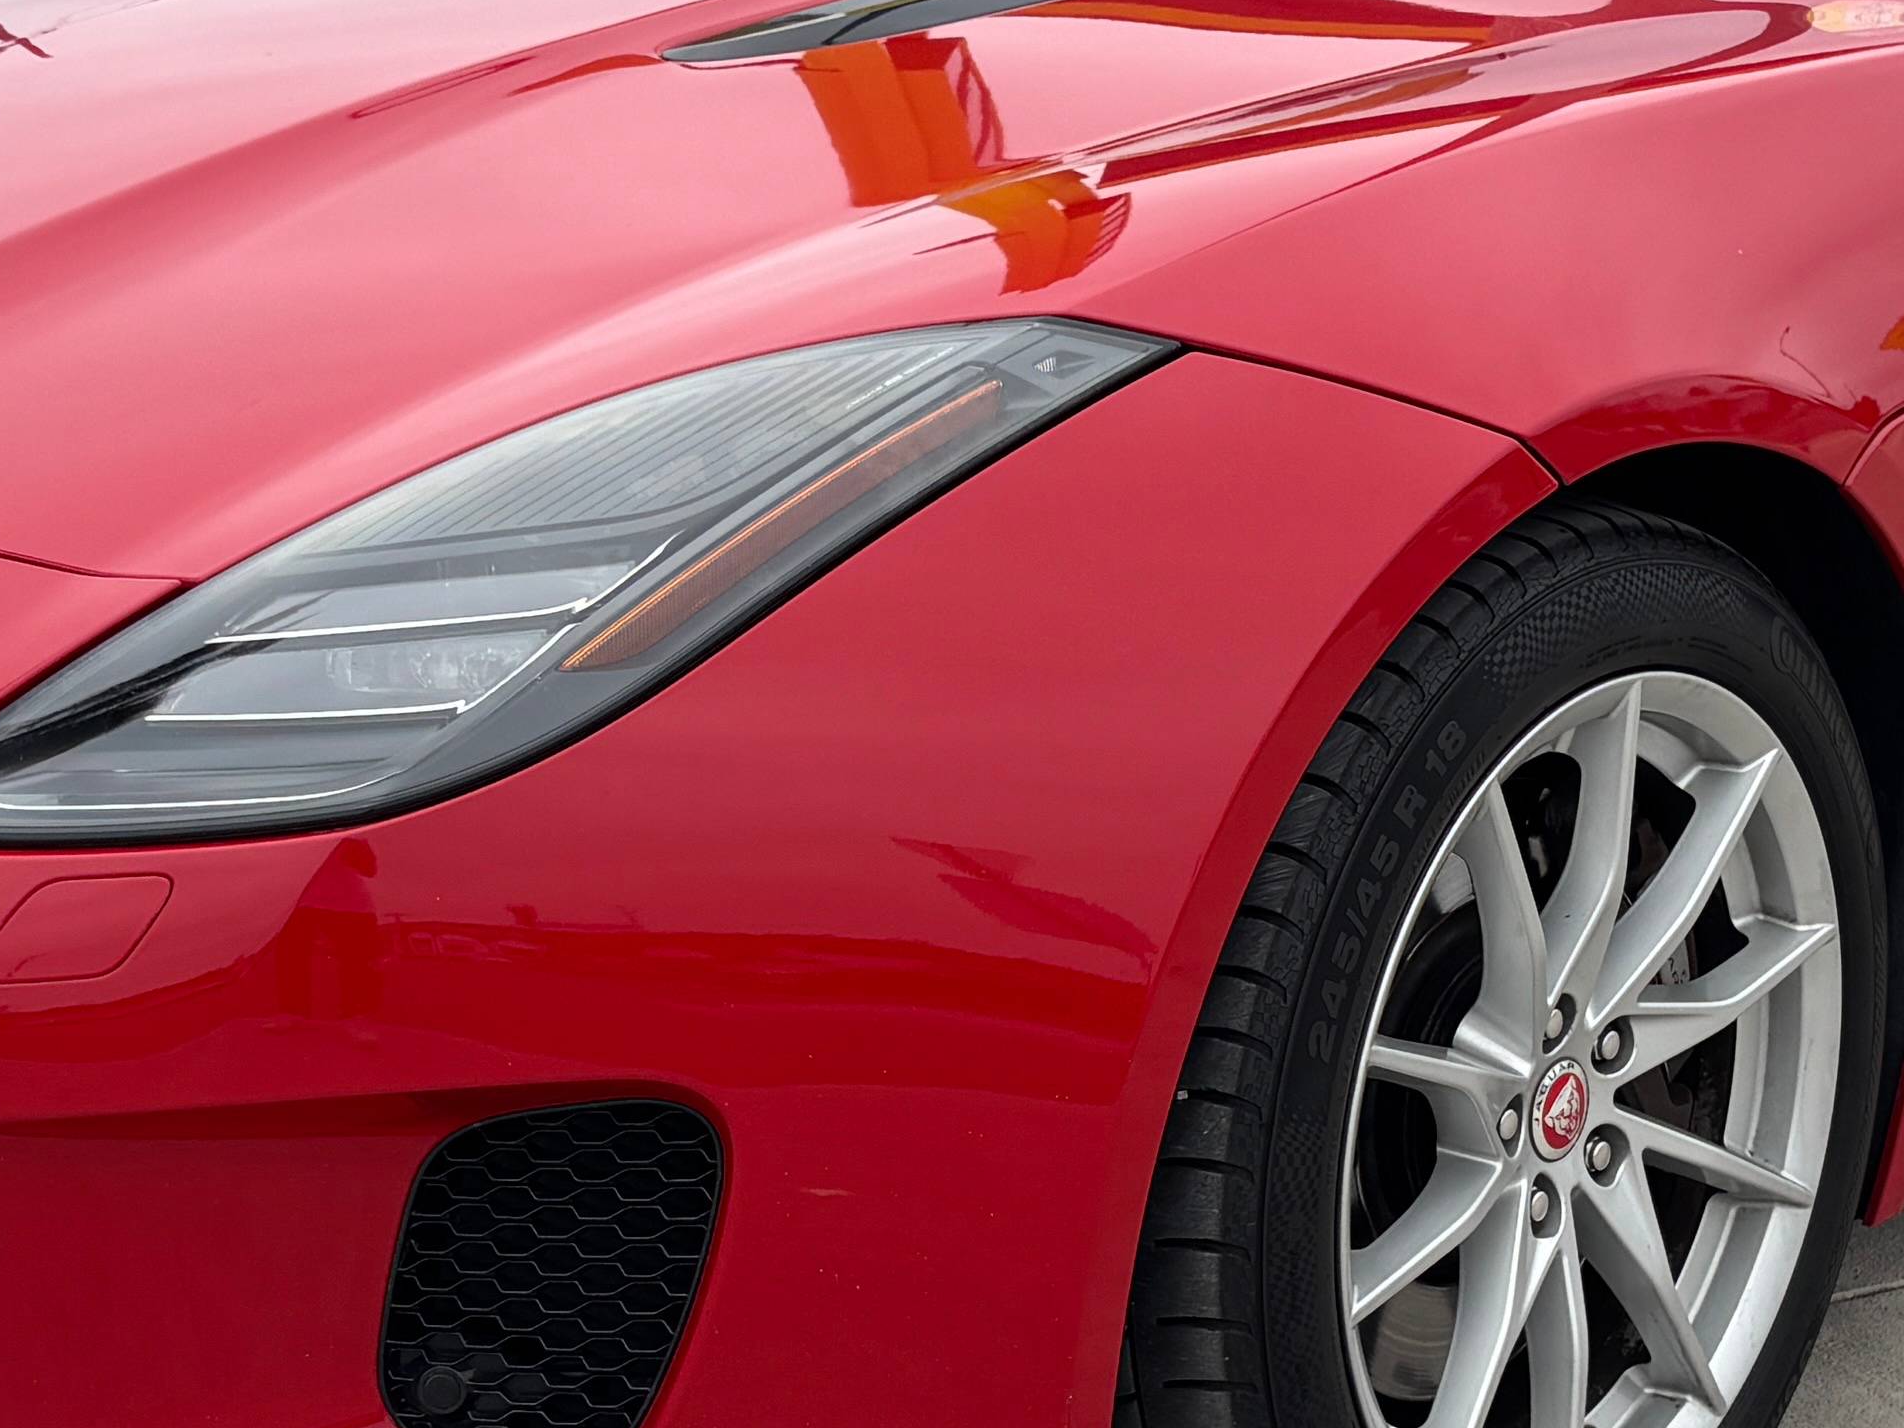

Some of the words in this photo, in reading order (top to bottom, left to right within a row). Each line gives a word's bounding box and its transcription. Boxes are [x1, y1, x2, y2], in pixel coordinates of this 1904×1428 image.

[1308, 833, 1400, 1065] 245/45
[1393, 783, 1427, 829] R
[1425, 720, 1468, 779] 18
[1534, 1062, 1575, 1128] JAGUAR
